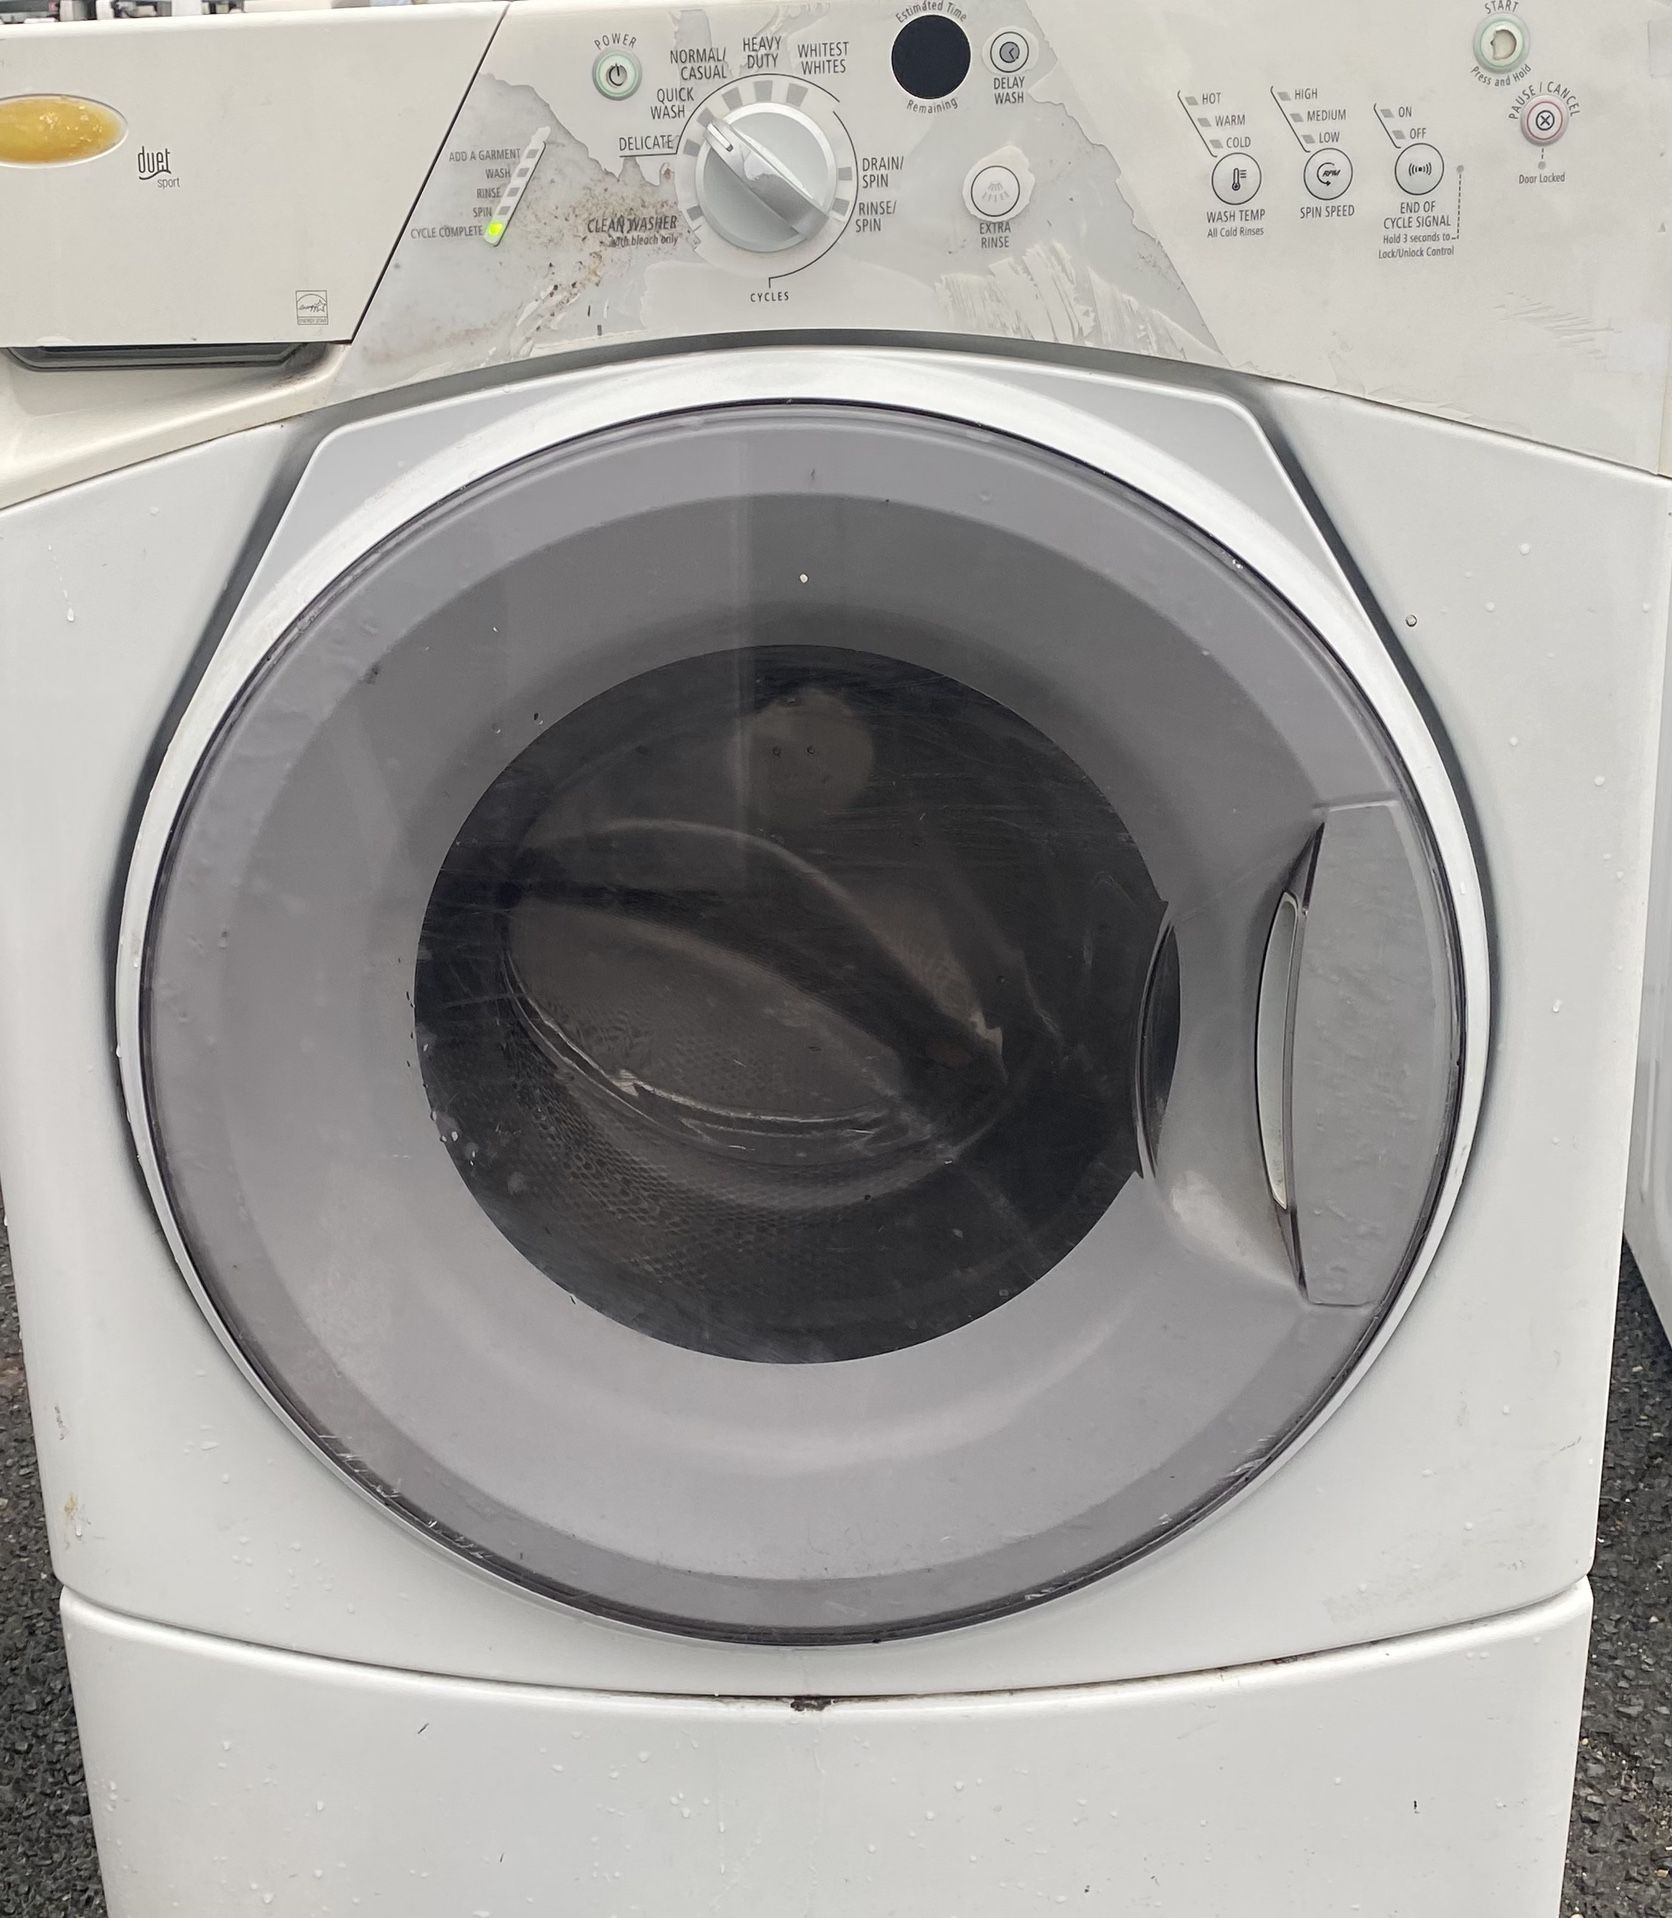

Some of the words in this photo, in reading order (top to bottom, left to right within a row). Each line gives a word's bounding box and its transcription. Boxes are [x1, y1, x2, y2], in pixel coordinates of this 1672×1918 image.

[895, 0, 943, 23] Estimated
[946, 1, 967, 22] Time
[1484, 0, 1519, 14] START
[594, 33, 637, 50] POWER
[743, 36, 782, 52] HEAVY
[670, 47, 727, 64] NORMAL/
[797, 41, 849, 58] WHITEST
[747, 54, 779, 69] DUTY
[801, 59, 847, 75] WHITES
[680, 65, 727, 81] CASUAL
[1471, 66, 1491, 86] Press
[1494, 78, 1511, 87] and
[1513, 64, 1532, 83] Hold
[993, 76, 1025, 90] DELAY
[656, 87, 694, 104] QUICK
[995, 91, 1024, 105] WASH
[1202, 92, 1221, 105] HOT
[1294, 88, 1318, 100] HIGH
[1508, 85, 1536, 120] PAUSE
[1547, 81, 1581, 117] CANCEL
[650, 104, 686, 120] WASH
[906, 97, 958, 114] Remaining
[1398, 106, 1412, 118] ON
[1215, 114, 1246, 127] WARM
[1307, 109, 1346, 122] MEDIUM
[1319, 131, 1340, 144] LOW
[1409, 127, 1427, 140] OFF
[619, 135, 674, 151] DELICATE
[1226, 136, 1251, 149] COLD
[449, 151, 468, 162] ADD
[470, 151, 477, 161] A
[478, 148, 521, 161] GARMENT
[137, 146, 171, 180] duet
[862, 156, 904, 172] DRAIN/
[485, 167, 511, 179] WASH
[1519, 174, 1537, 184] Door
[1539, 172, 1566, 183] Locked
[157, 177, 180, 189] sport
[862, 173, 889, 189] SPIN
[476, 186, 501, 199] RINSE
[472, 207, 492, 218] SPIN
[858, 200, 896, 216] RINSE/
[1300, 206, 1322, 219] SPIN
[1325, 204, 1355, 218] SPEED
[1400, 201, 1420, 214] END
[1423, 200, 1436, 213] OF
[1207, 211, 1236, 223] WASH
[1238, 208, 1266, 222] TEMP
[1383, 216, 1412, 230] CYCLE
[1416, 215, 1451, 229] SIGNAL
[587, 216, 625, 234] CLEAN
[628, 215, 678, 234] WASHER
[855, 216, 882, 233] SPIN
[979, 221, 1011, 235] EXTRA
[410, 227, 437, 239] CYCLE
[438, 225, 483, 238] COMPLETE
[1207, 228, 1218, 238] All
[1220, 226, 1237, 238] Cold
[1240, 226, 1264, 236] Rinses
[1383, 232, 1401, 244] Hold
[1403, 232, 1408, 243] 3
[1410, 231, 1440, 242] seconds
[1442, 233, 1450, 241] to
[631, 233, 659, 246] bleach
[660, 234, 679, 246] only
[980, 236, 1010, 249] RINSE
[1378, 248, 1425, 259] Lock/Unlock
[1426, 245, 1454, 257] Control
[750, 291, 789, 303] CYCLES
